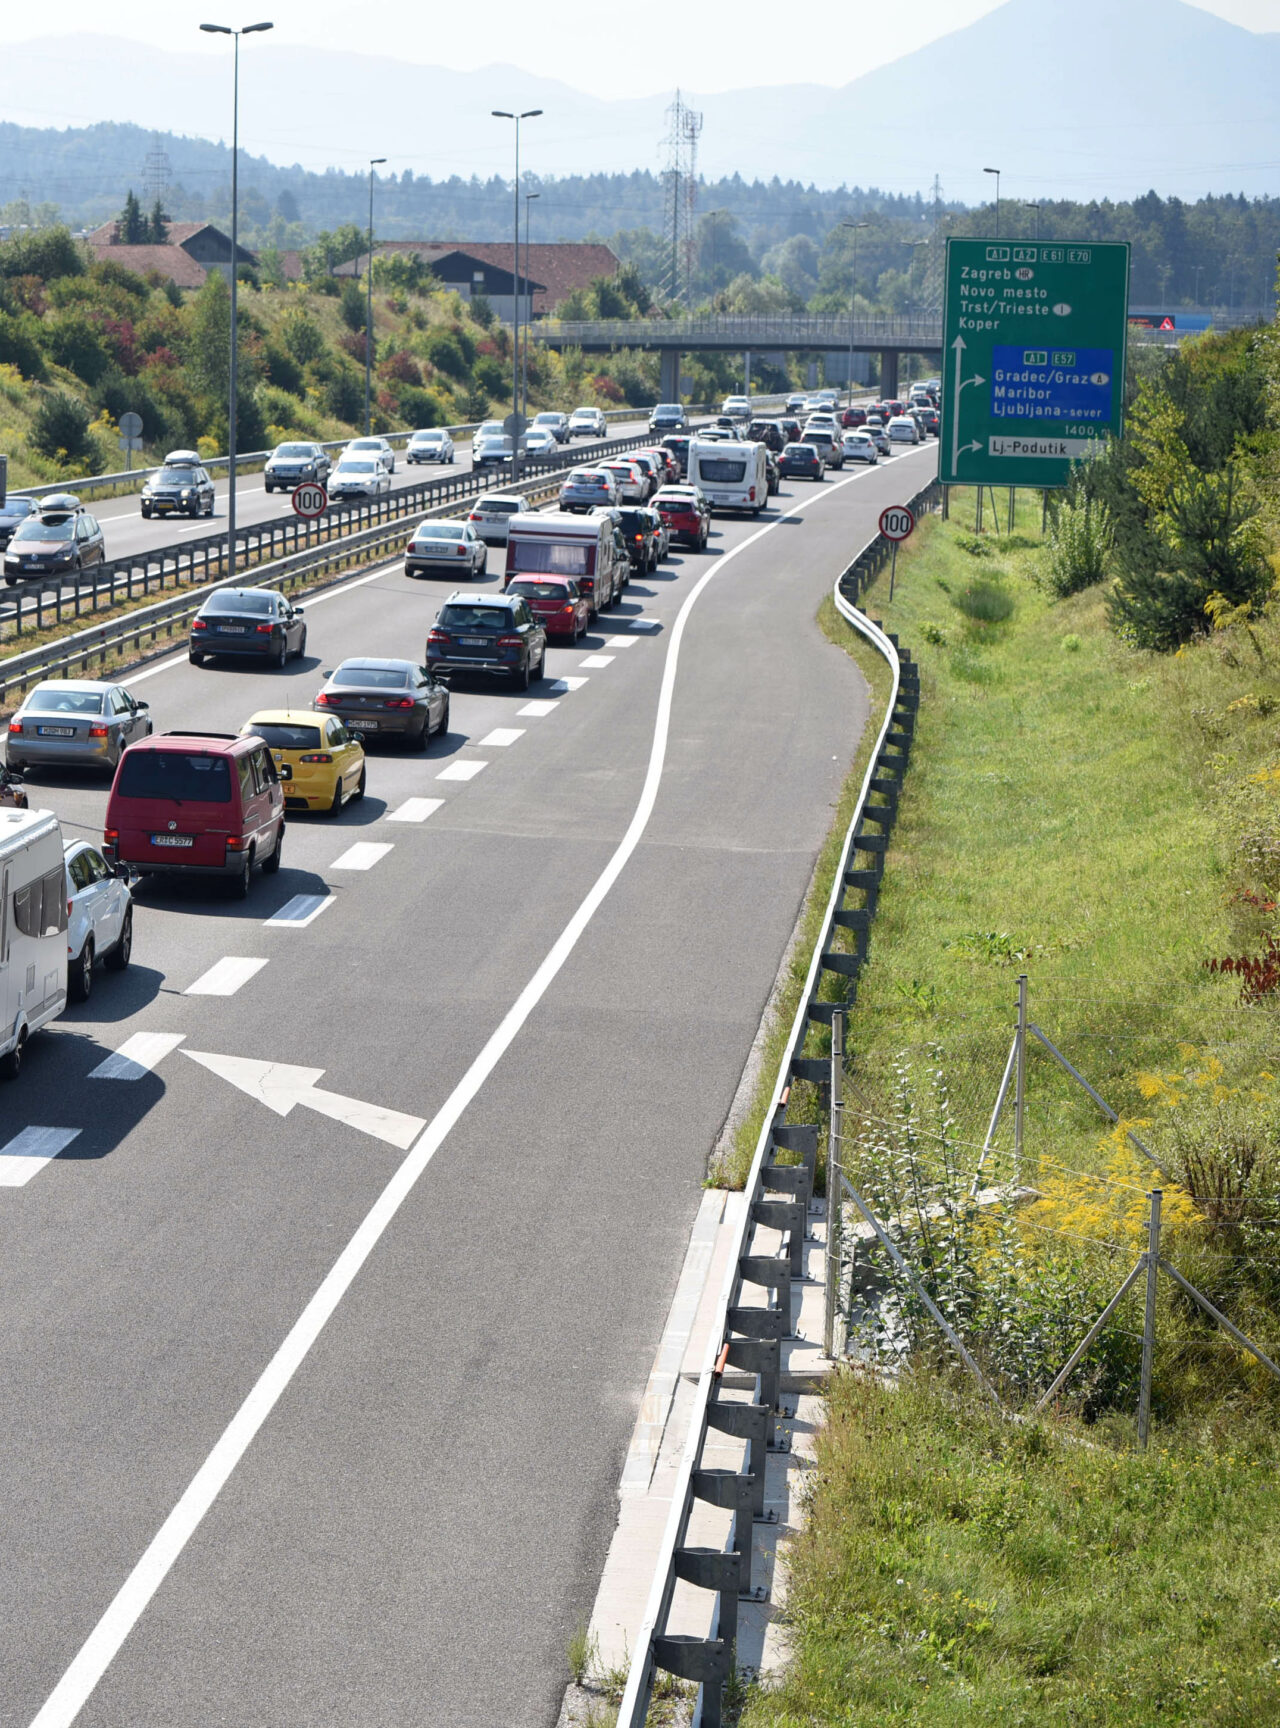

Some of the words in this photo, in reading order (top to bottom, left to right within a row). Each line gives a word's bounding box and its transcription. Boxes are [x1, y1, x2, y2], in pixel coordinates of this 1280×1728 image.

[991, 249, 1003, 259] A1
[1018, 250, 1031, 260] A2
[961, 266, 1012, 282] Zagreb
[960, 284, 996, 297] Novo
[1003, 287, 1048, 299] mesto
[961, 300, 1049, 315] Trst/Trieste
[959, 317, 1000, 332] Koper
[1029, 353, 1041, 363] A1
[995, 369, 1089, 385] Gradec/Graz
[994, 385, 1052, 400] Maribor
[1065, 425, 1094, 436] 1400
[297, 491, 323, 510] 100
[885, 513, 910, 533] 100
